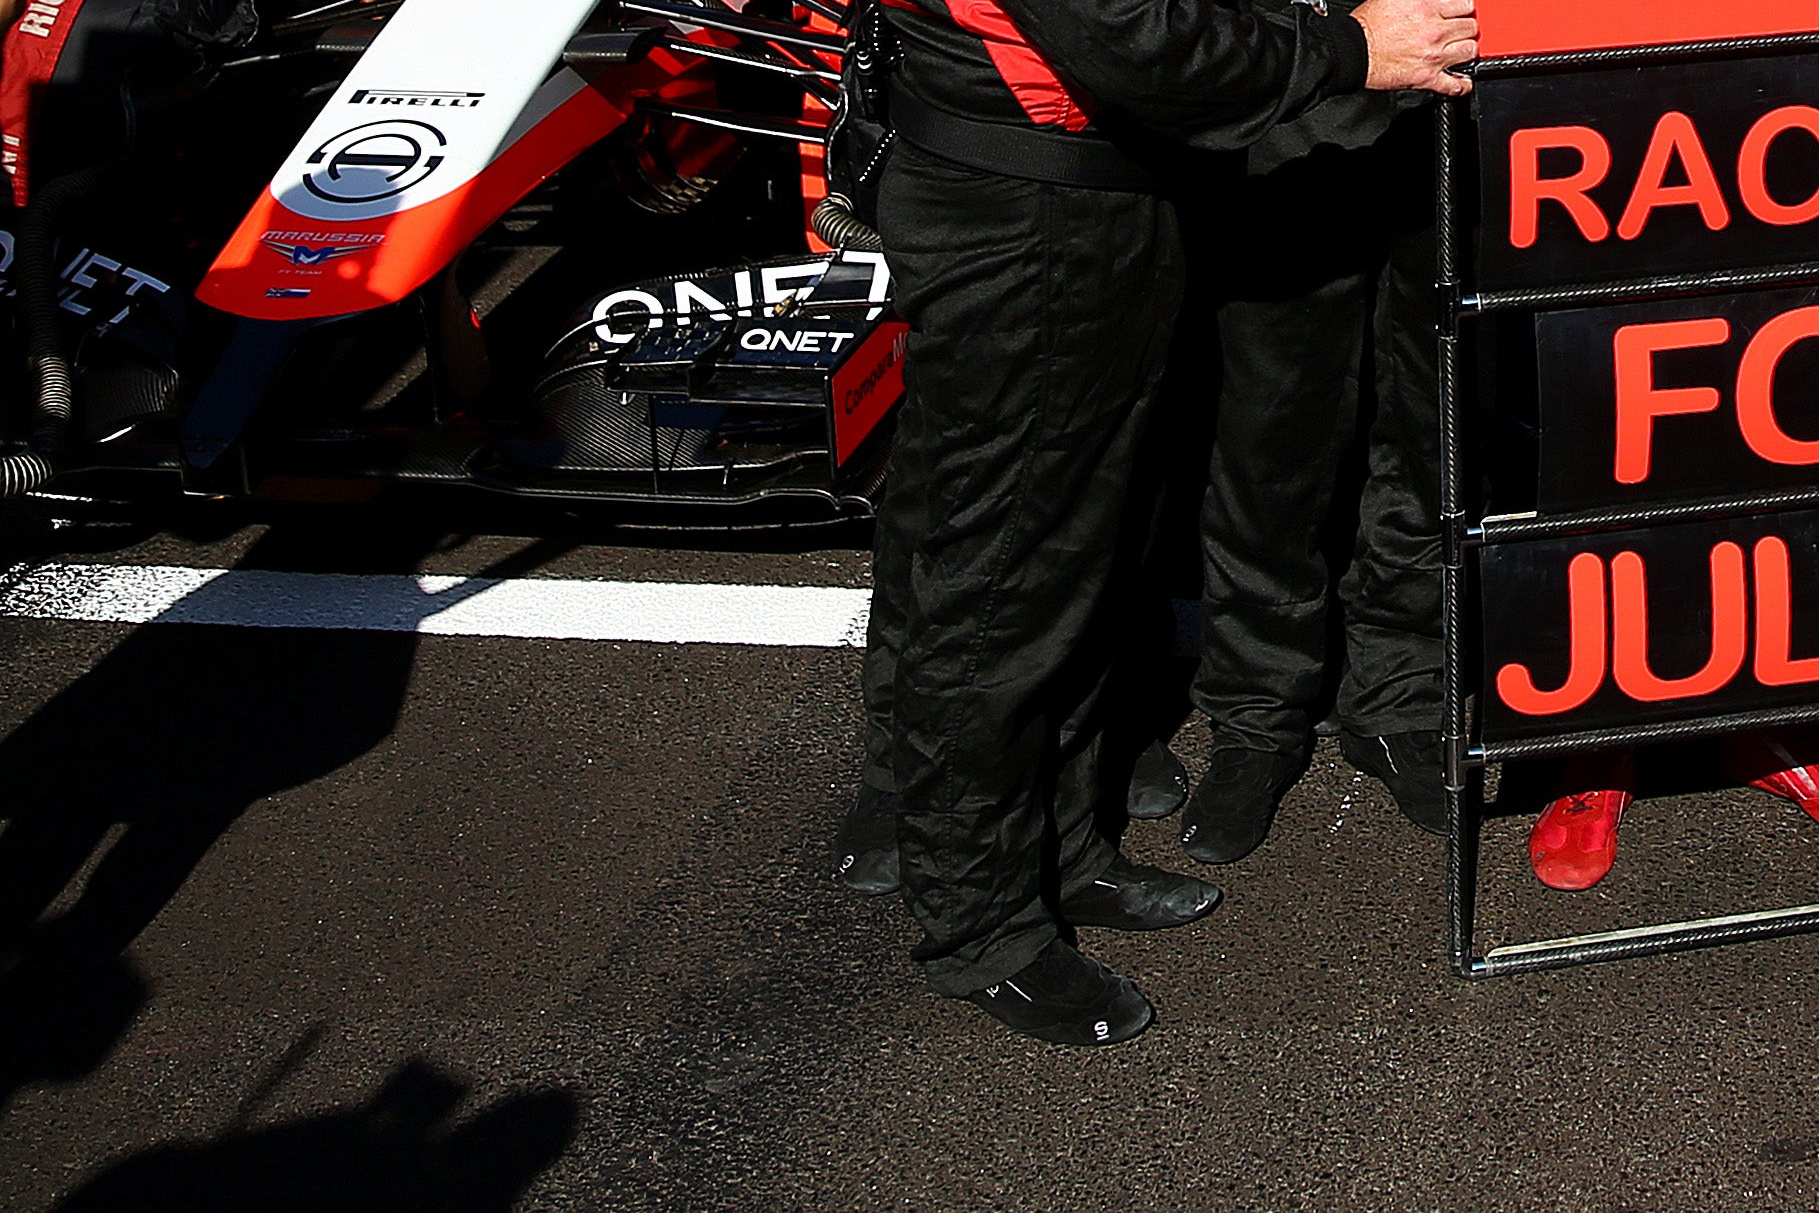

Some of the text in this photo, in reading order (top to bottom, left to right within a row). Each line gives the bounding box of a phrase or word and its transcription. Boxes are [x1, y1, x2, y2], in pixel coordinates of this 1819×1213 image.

[348, 89, 487, 108] PIRELLI
[260, 231, 387, 244] MARUSSIA
[741, 328, 855, 353] QNET
[844, 332, 908, 415] CompareM
